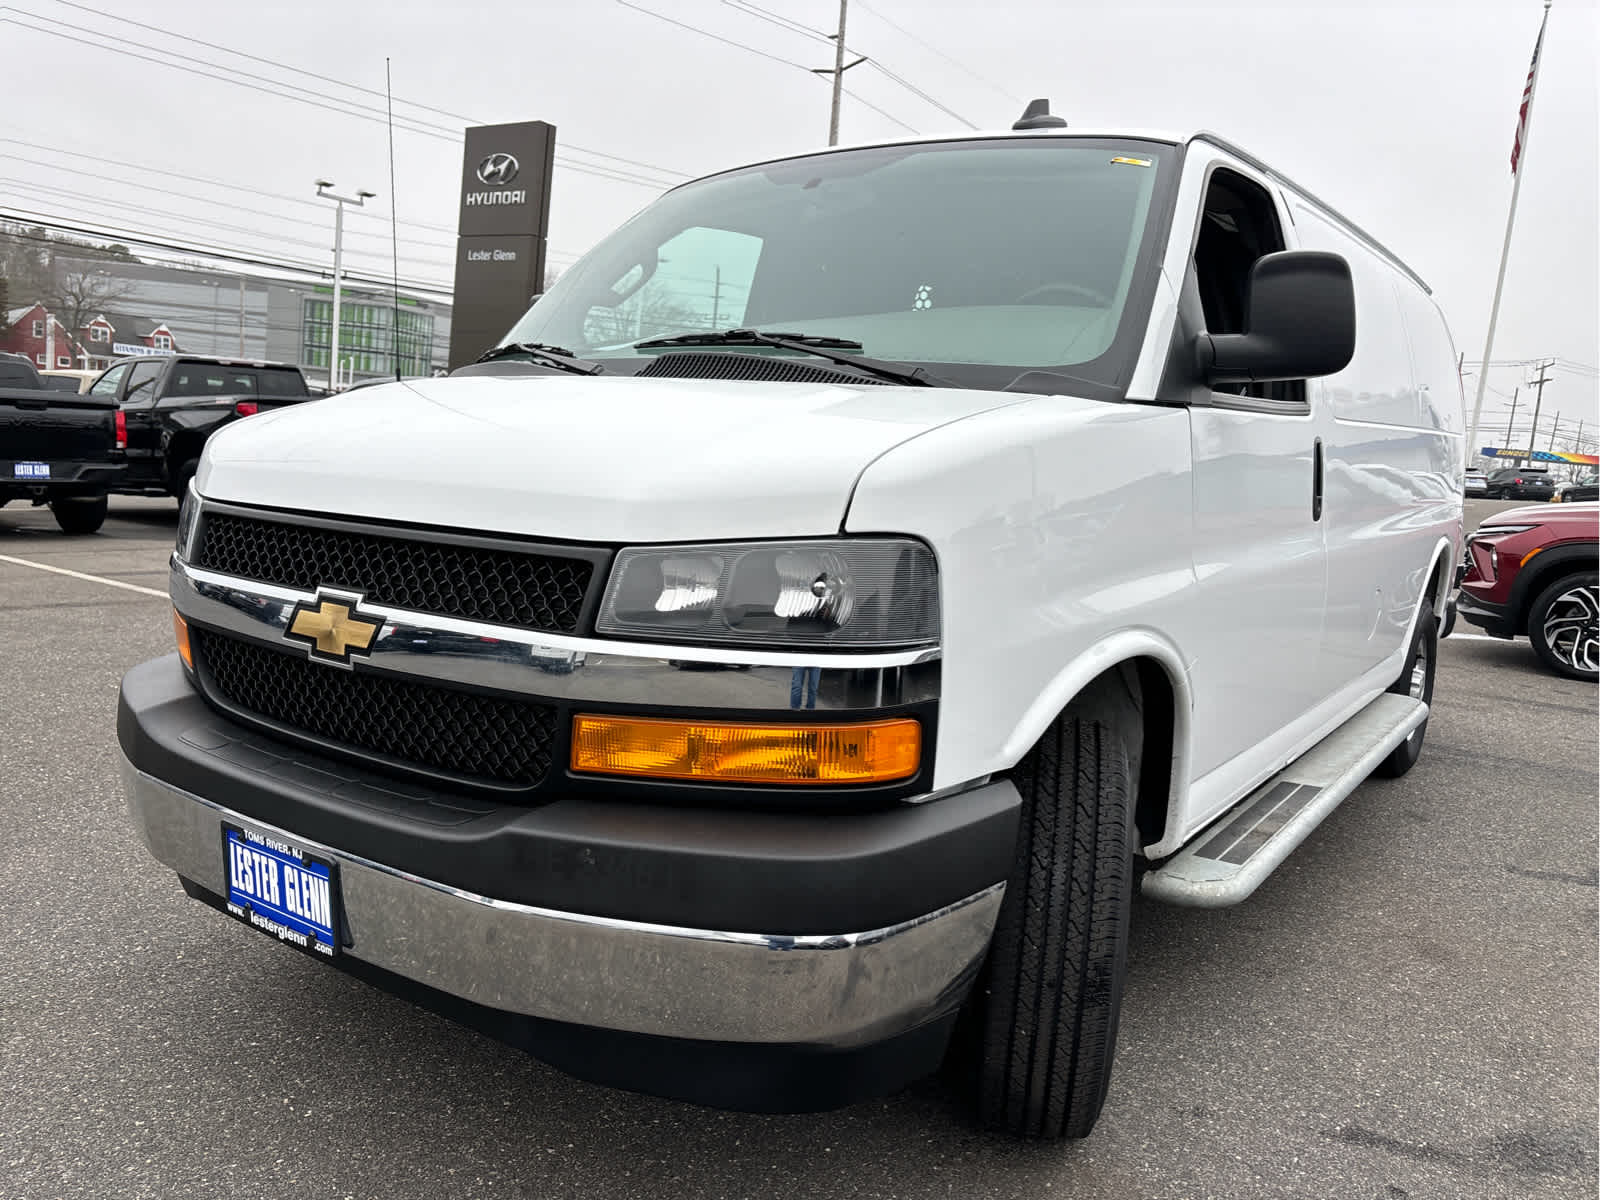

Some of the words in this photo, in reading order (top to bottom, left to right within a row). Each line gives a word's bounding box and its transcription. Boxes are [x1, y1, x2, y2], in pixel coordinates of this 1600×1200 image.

[466, 190, 526, 206] HYUNDAI
[467, 249, 492, 261] Lester
[493, 249, 516, 261] Glenn
[243, 829, 265, 845] TOMS
[292, 847, 303, 860] NJ
[229, 842, 280, 906] LESTER
[283, 864, 332, 929] GLENN
